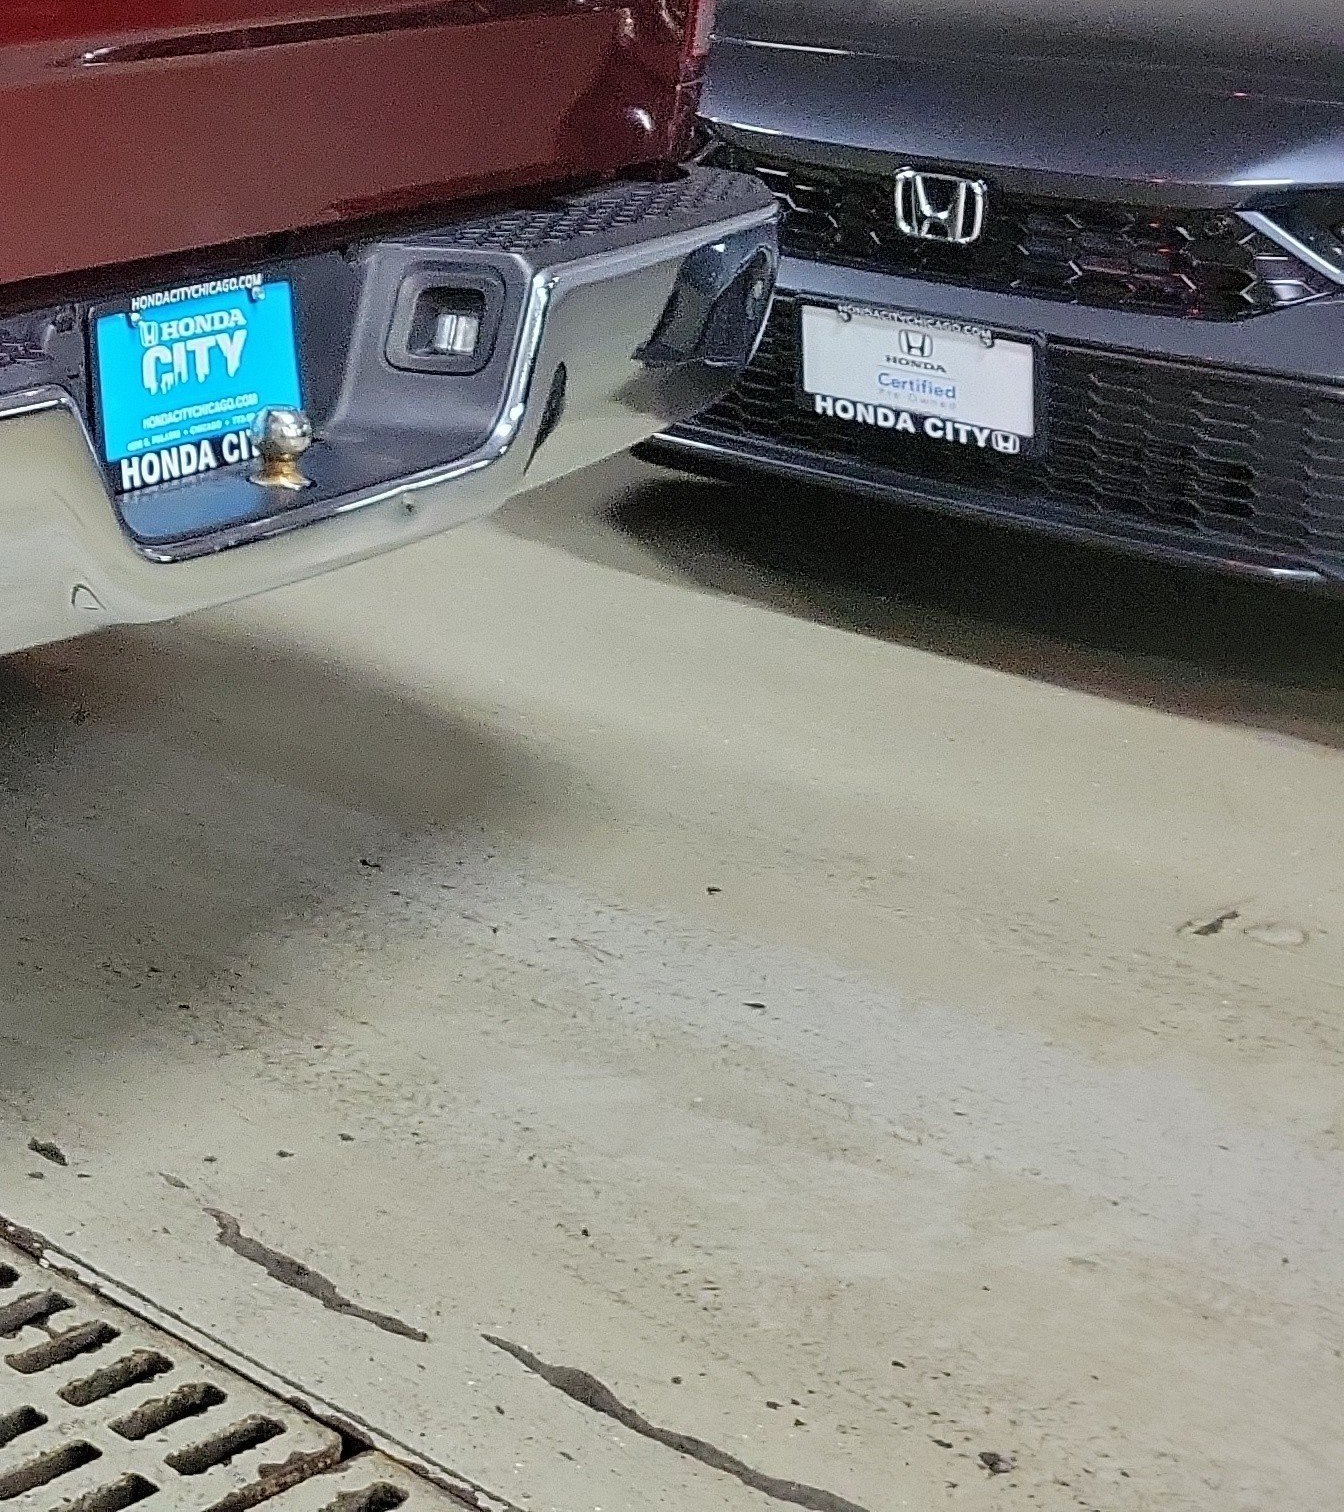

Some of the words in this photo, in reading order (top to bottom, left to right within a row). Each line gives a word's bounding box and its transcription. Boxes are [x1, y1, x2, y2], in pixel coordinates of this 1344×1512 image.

[131, 273, 262, 311] HONDACITYCHICAGO.COM
[160, 308, 247, 341] HONDA
[141, 328, 248, 396] CITY
[885, 354, 947, 373] HONDA
[878, 372, 956, 399] Certified
[815, 394, 916, 434] HONDA
[924, 416, 990, 448] CITY
[120, 440, 217, 490] HONDA
[221, 429, 261, 465] CI
